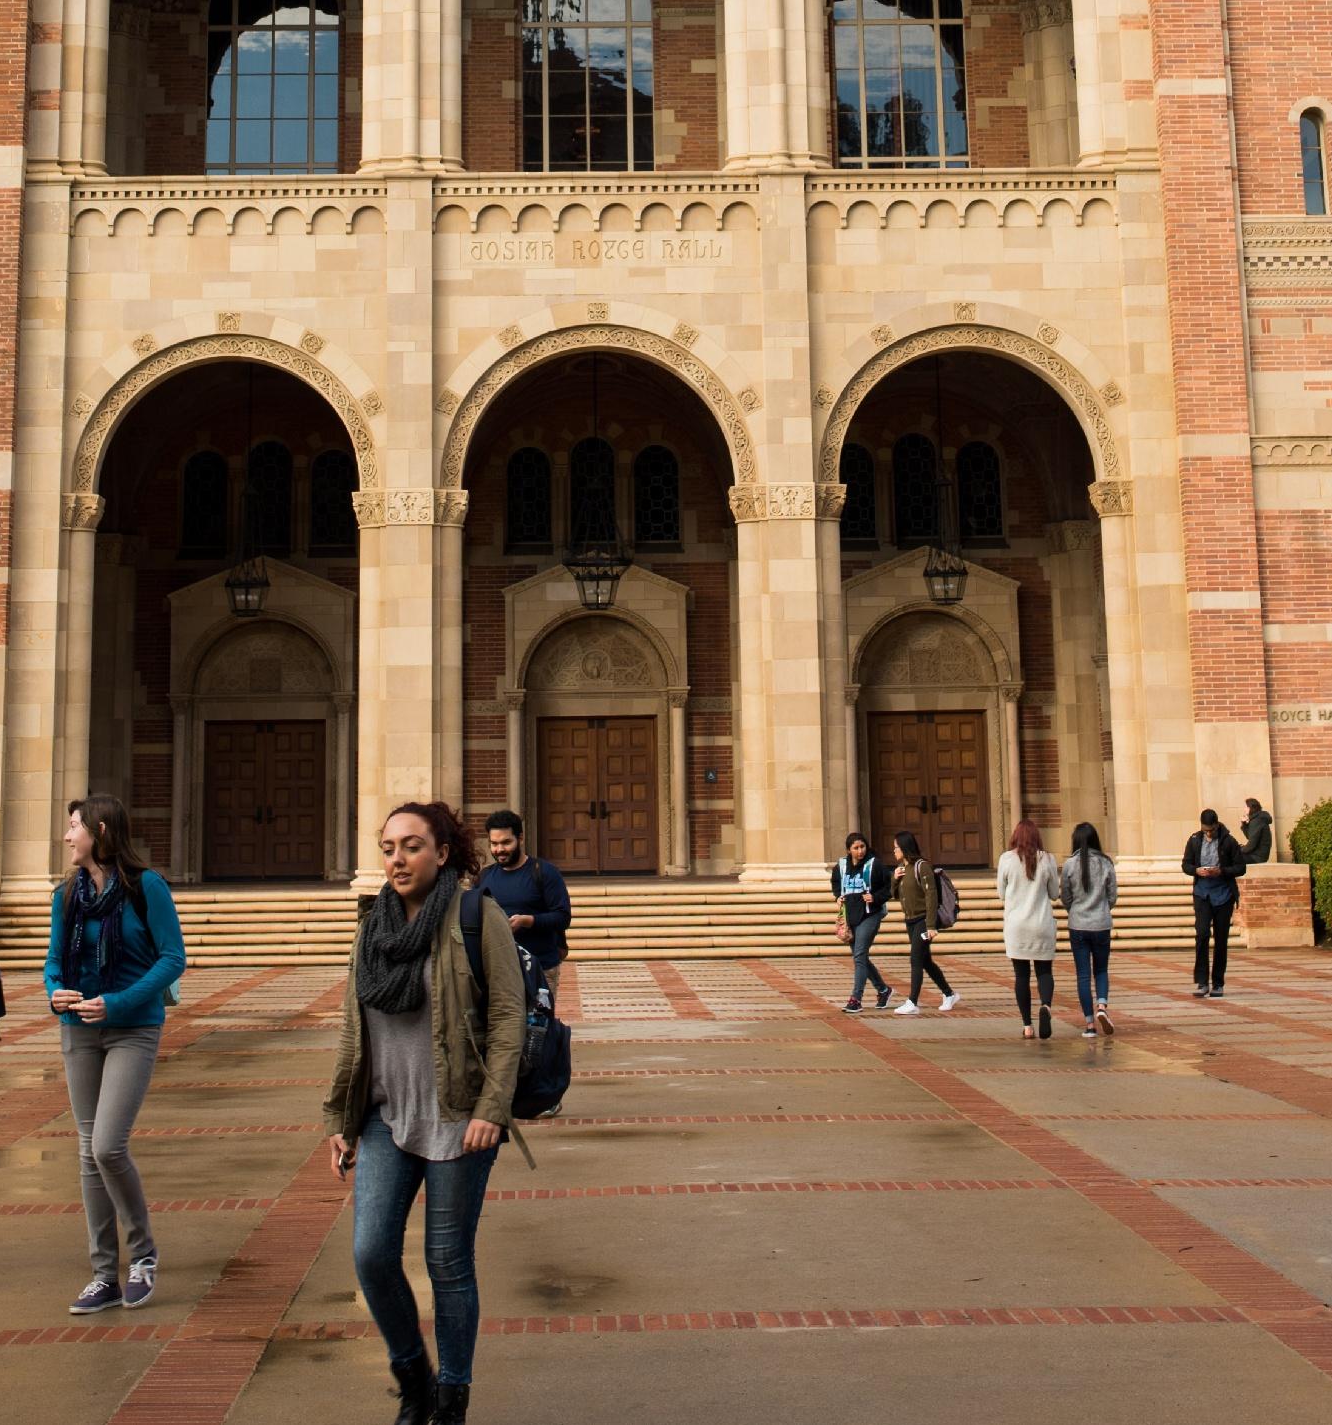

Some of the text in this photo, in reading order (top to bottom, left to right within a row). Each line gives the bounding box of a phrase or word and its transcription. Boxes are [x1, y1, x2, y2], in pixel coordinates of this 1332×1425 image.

[470, 239, 723, 261] JOSIAH ROYCE HALL
[1271, 710, 1312, 722] ROYCE
